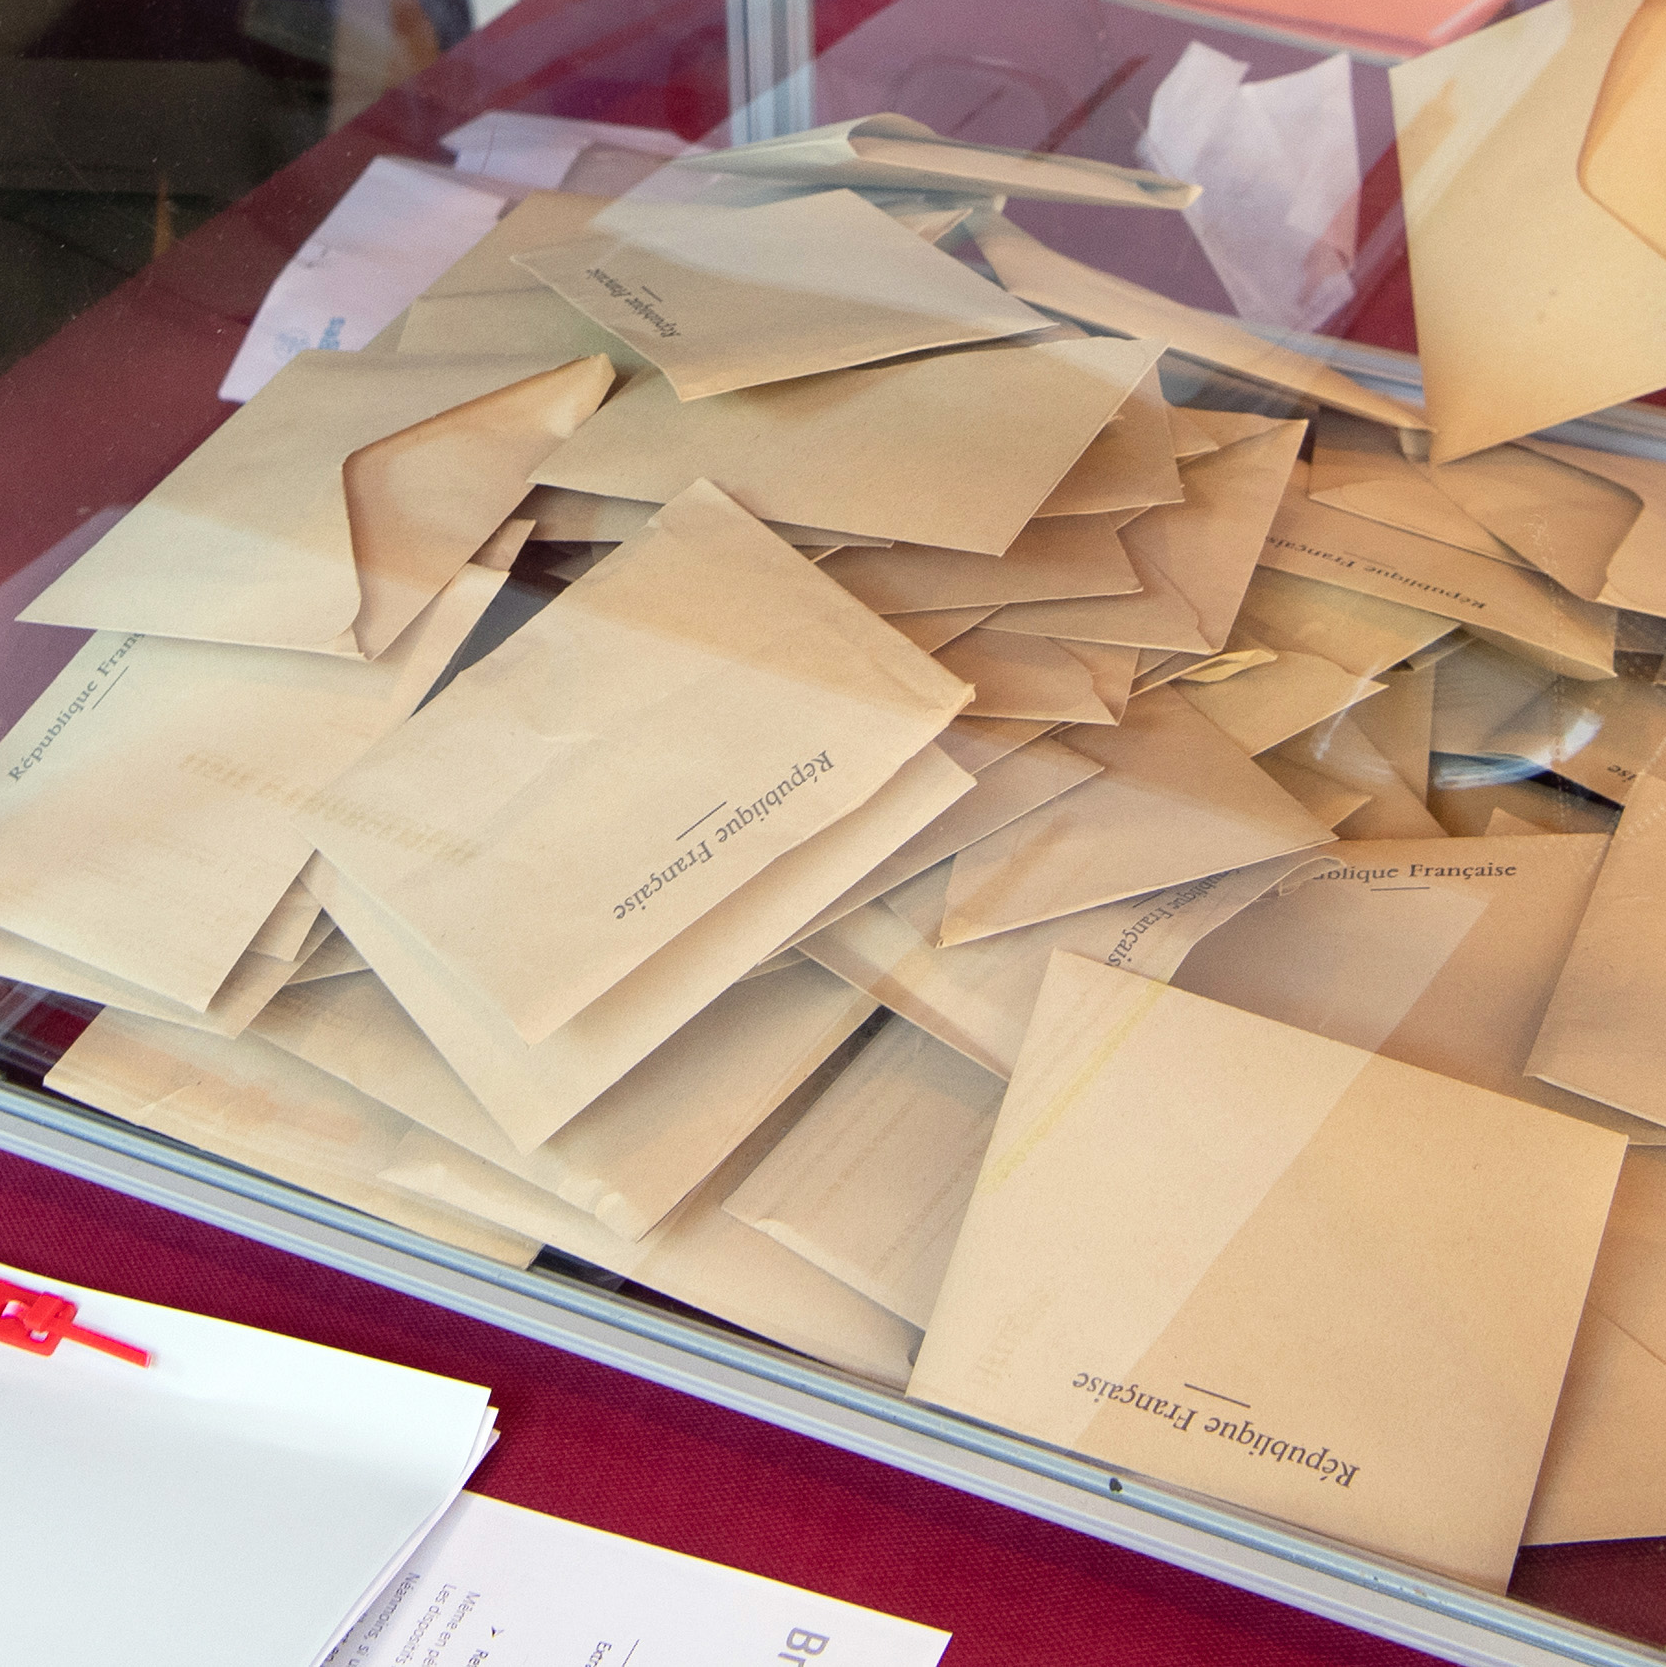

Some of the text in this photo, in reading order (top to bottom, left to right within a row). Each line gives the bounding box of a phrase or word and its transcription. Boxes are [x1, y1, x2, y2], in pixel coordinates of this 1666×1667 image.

[8, 680, 98, 782] République
[613, 749, 835, 920] République Française
[1312, 862, 1517, 884] blique Française
[1105, 907, 1173, 967] Français
[1072, 1371, 1361, 1488] République Française
[363, 1572, 420, 1640] Néanmoins,
[395, 1584, 457, 1664] Les dispositifs
[435, 1631, 451, 1647] en
[447, 1591, 481, 1630] Même
